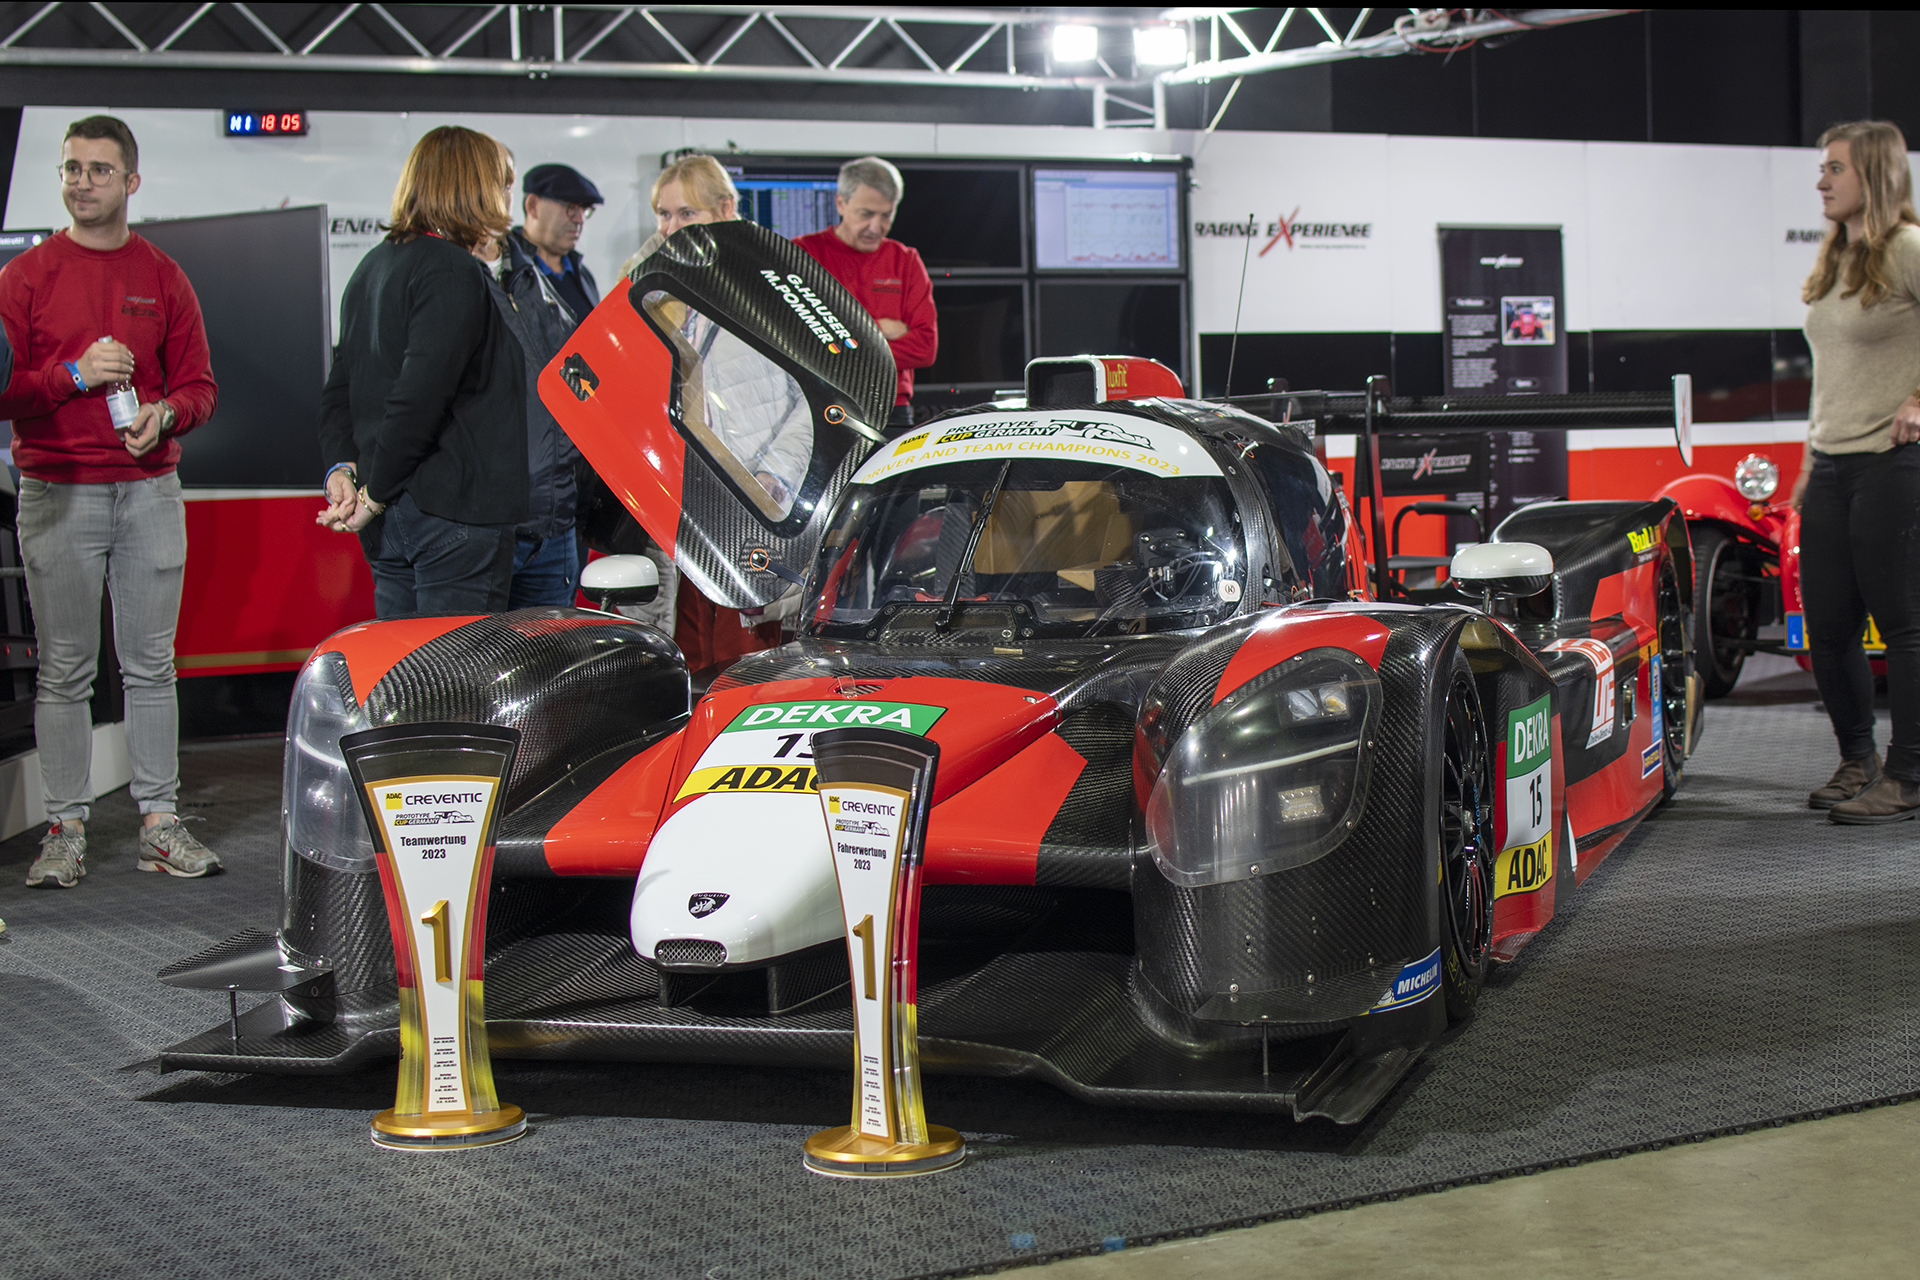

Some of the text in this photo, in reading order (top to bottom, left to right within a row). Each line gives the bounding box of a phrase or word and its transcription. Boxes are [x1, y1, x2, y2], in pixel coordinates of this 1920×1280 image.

[281, 114, 300, 131] 05
[760, 270, 834, 345] M.POMMER
[787, 274, 851, 340] G.HAUSER
[940, 426, 1058, 443] CUP GERMANY
[945, 420, 1038, 435] PROTOTYPE
[899, 432, 931, 447] ADAC
[861, 441, 1181, 484] DRIVER AND TEAM CHAMPIONS 2023
[742, 705, 912, 728] DEKRA
[1514, 707, 1550, 764] DEKRA
[405, 792, 483, 806] CREVENTIC
[841, 800, 896, 817] CREVENTIC
[1529, 773, 1543, 829] 15
[400, 834, 467, 847] Teamwertung
[837, 842, 887, 859] Fahrerwertung
[421, 848, 446, 860] 2023
[853, 858, 871, 871] 2023
[1507, 838, 1548, 891] ADAC
[420, 899, 453, 983] 1
[852, 913, 877, 1001] 1
[1396, 963, 1438, 996] MICHELIN
